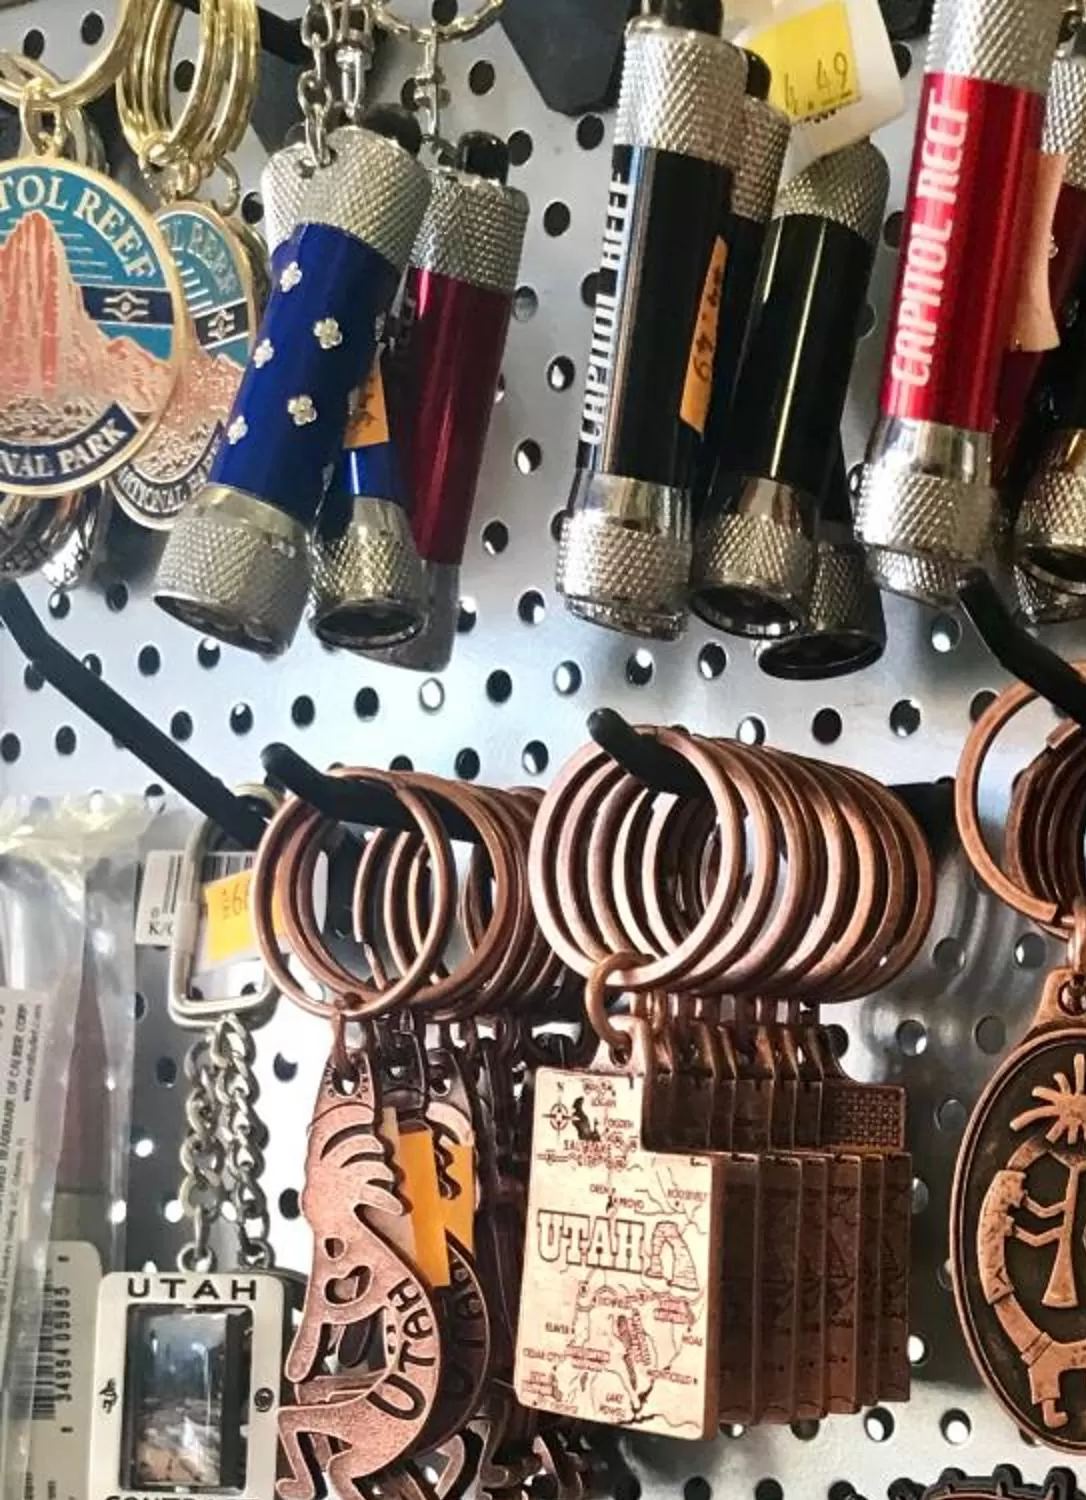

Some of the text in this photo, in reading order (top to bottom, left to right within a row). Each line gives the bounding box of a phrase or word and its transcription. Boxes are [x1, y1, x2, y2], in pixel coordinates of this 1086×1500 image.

[73, 187, 156, 279] REEF
[890, 87, 970, 388] CAPITOL REEF
[56, 418, 128, 475] PARK
[537, 1208, 646, 1275] UTAH
[127, 1277, 257, 1301] UTAH
